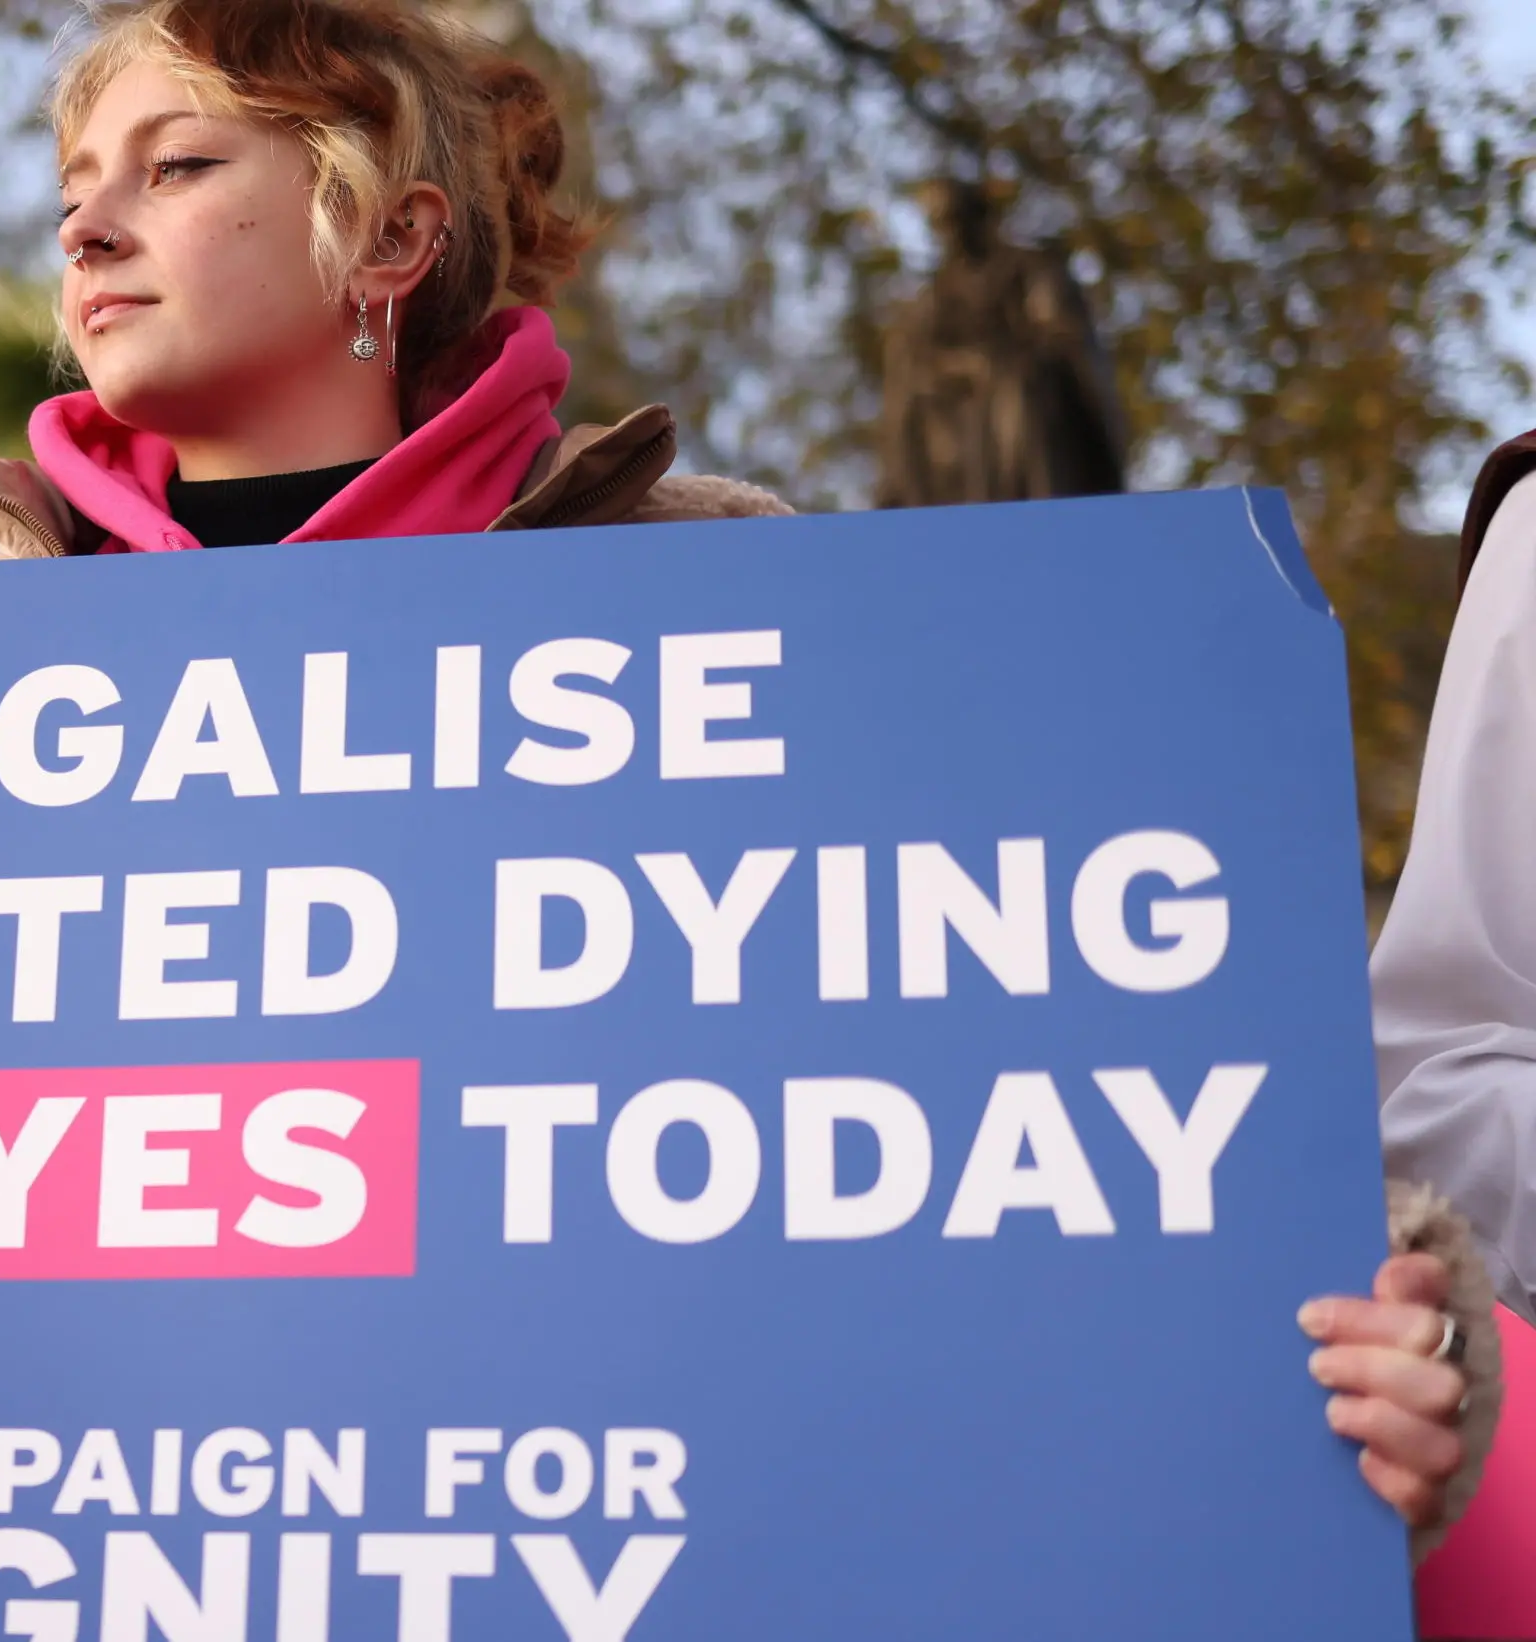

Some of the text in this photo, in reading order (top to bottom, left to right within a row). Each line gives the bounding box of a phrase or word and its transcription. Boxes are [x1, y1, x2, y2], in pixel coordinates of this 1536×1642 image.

[491, 828, 1231, 1011] DYING
[460, 1062, 1269, 1245] TODAY
[423, 1425, 688, 1521] FOR
